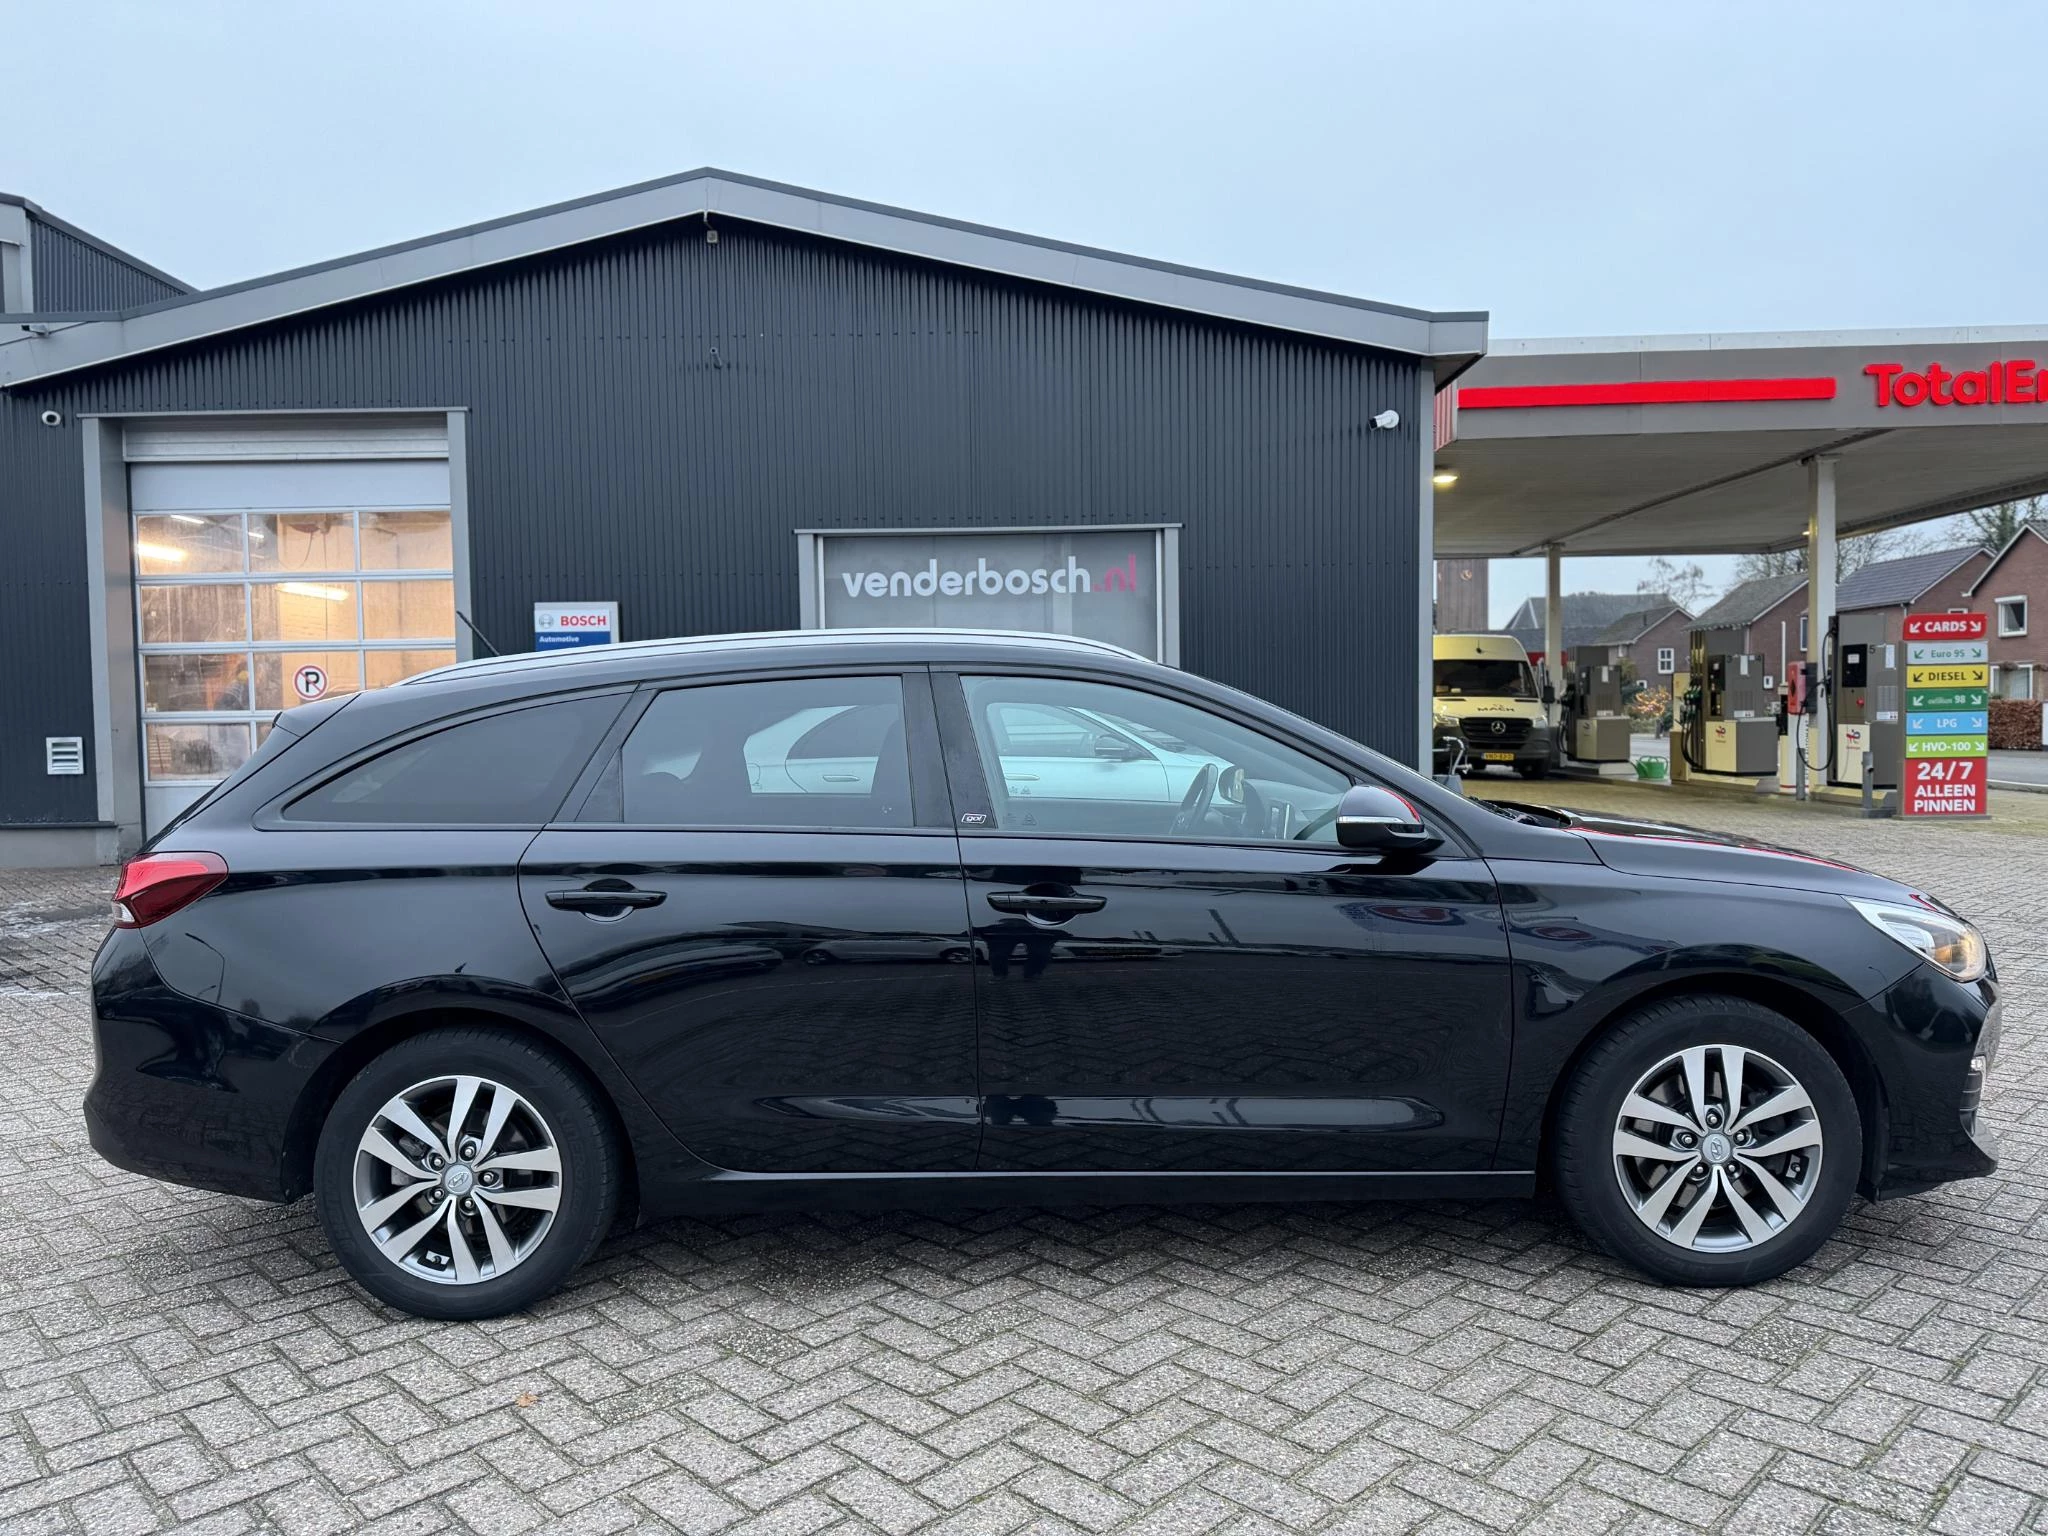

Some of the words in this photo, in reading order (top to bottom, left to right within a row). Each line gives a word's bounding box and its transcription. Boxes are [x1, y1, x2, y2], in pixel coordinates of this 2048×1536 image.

[842, 554, 1136, 597] venderbosch.nl
[560, 615, 606, 626] BOSCH
[1924, 621, 1967, 633] CARDS
[1930, 650, 1951, 658] Euro
[1953, 649, 1965, 657] 95
[305, 671, 320, 693] P
[1928, 672, 1966, 681] DIESEL
[1954, 695, 1966, 704] 98
[1936, 718, 1957, 728] LPG
[1922, 742, 1971, 752] HVO-100
[1917, 761, 1973, 780] 24/7
[1914, 784, 1976, 797] ALLEEN
[1914, 799, 1976, 812] PINNEN
